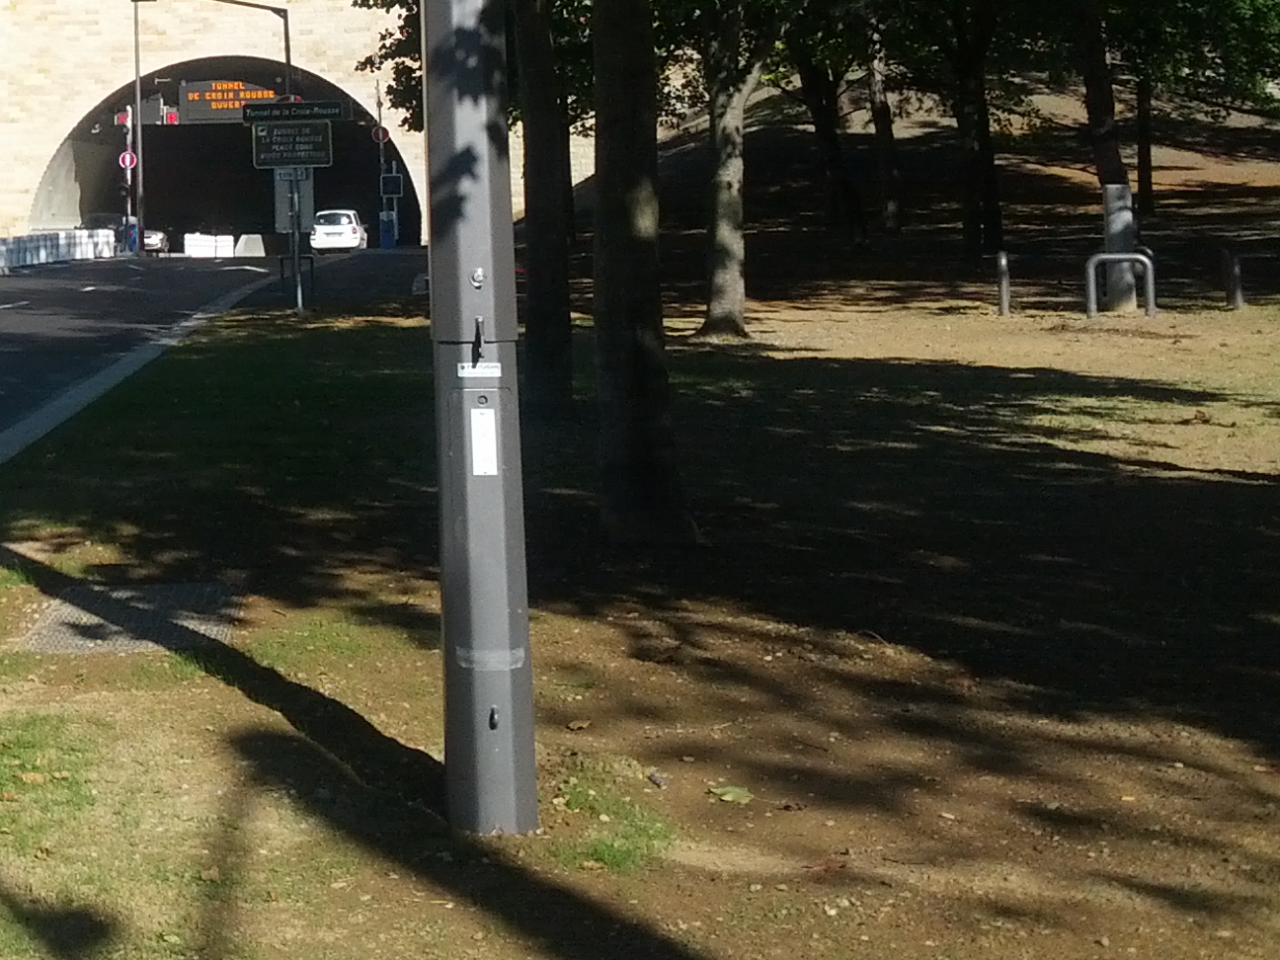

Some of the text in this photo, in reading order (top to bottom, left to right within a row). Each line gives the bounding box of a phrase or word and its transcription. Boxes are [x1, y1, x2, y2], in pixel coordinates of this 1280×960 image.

[211, 82, 245, 90] TUNNEL
[188, 90, 275, 101] DE CROIX ROUSSE
[210, 101, 247, 109] OUVERT
[246, 107, 270, 116] Tunnel
[282, 107, 290, 116] la
[291, 106, 340, 116] Croix-Rousse
